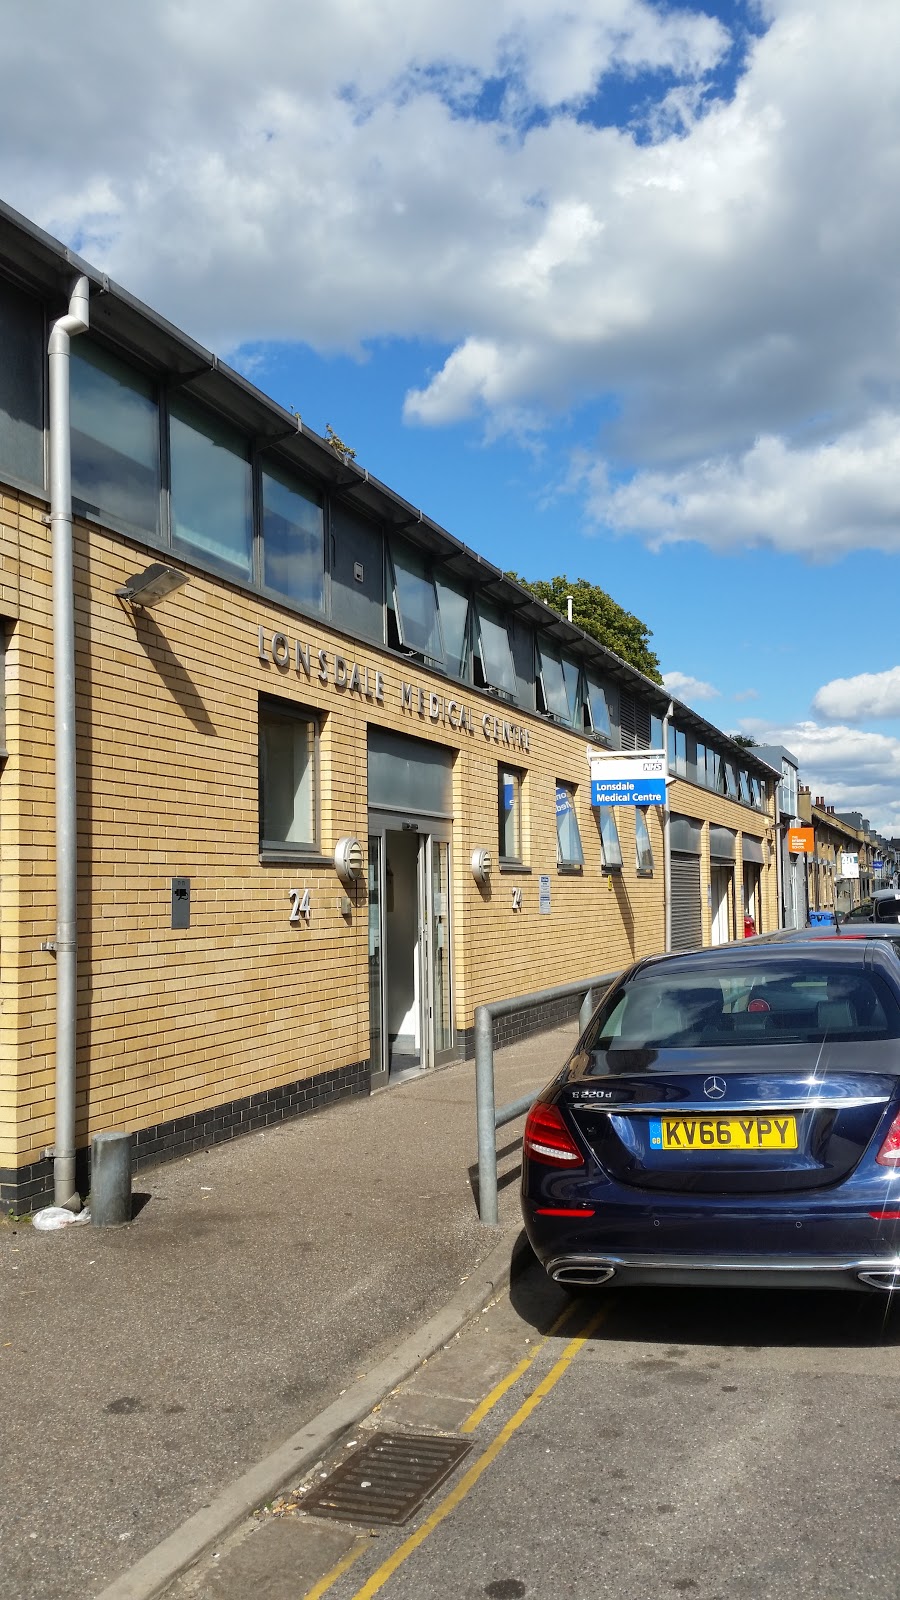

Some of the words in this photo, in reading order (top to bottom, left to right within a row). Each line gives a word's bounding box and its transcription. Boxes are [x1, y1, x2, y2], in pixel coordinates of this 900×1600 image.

[259, 625, 385, 701] LONSDALE
[401, 682, 475, 731] MEDICAL
[482, 713, 530, 750] CENTRE
[643, 763, 662, 771] NHS
[596, 793, 630, 802] Medical
[632, 793, 662, 802] Centre
[597, 782, 635, 791] Lonsdale
[288, 889, 310, 920] 24
[512, 887, 523, 909] 24
[666, 1121, 731, 1145] KV66
[739, 1119, 789, 1145] YPY
